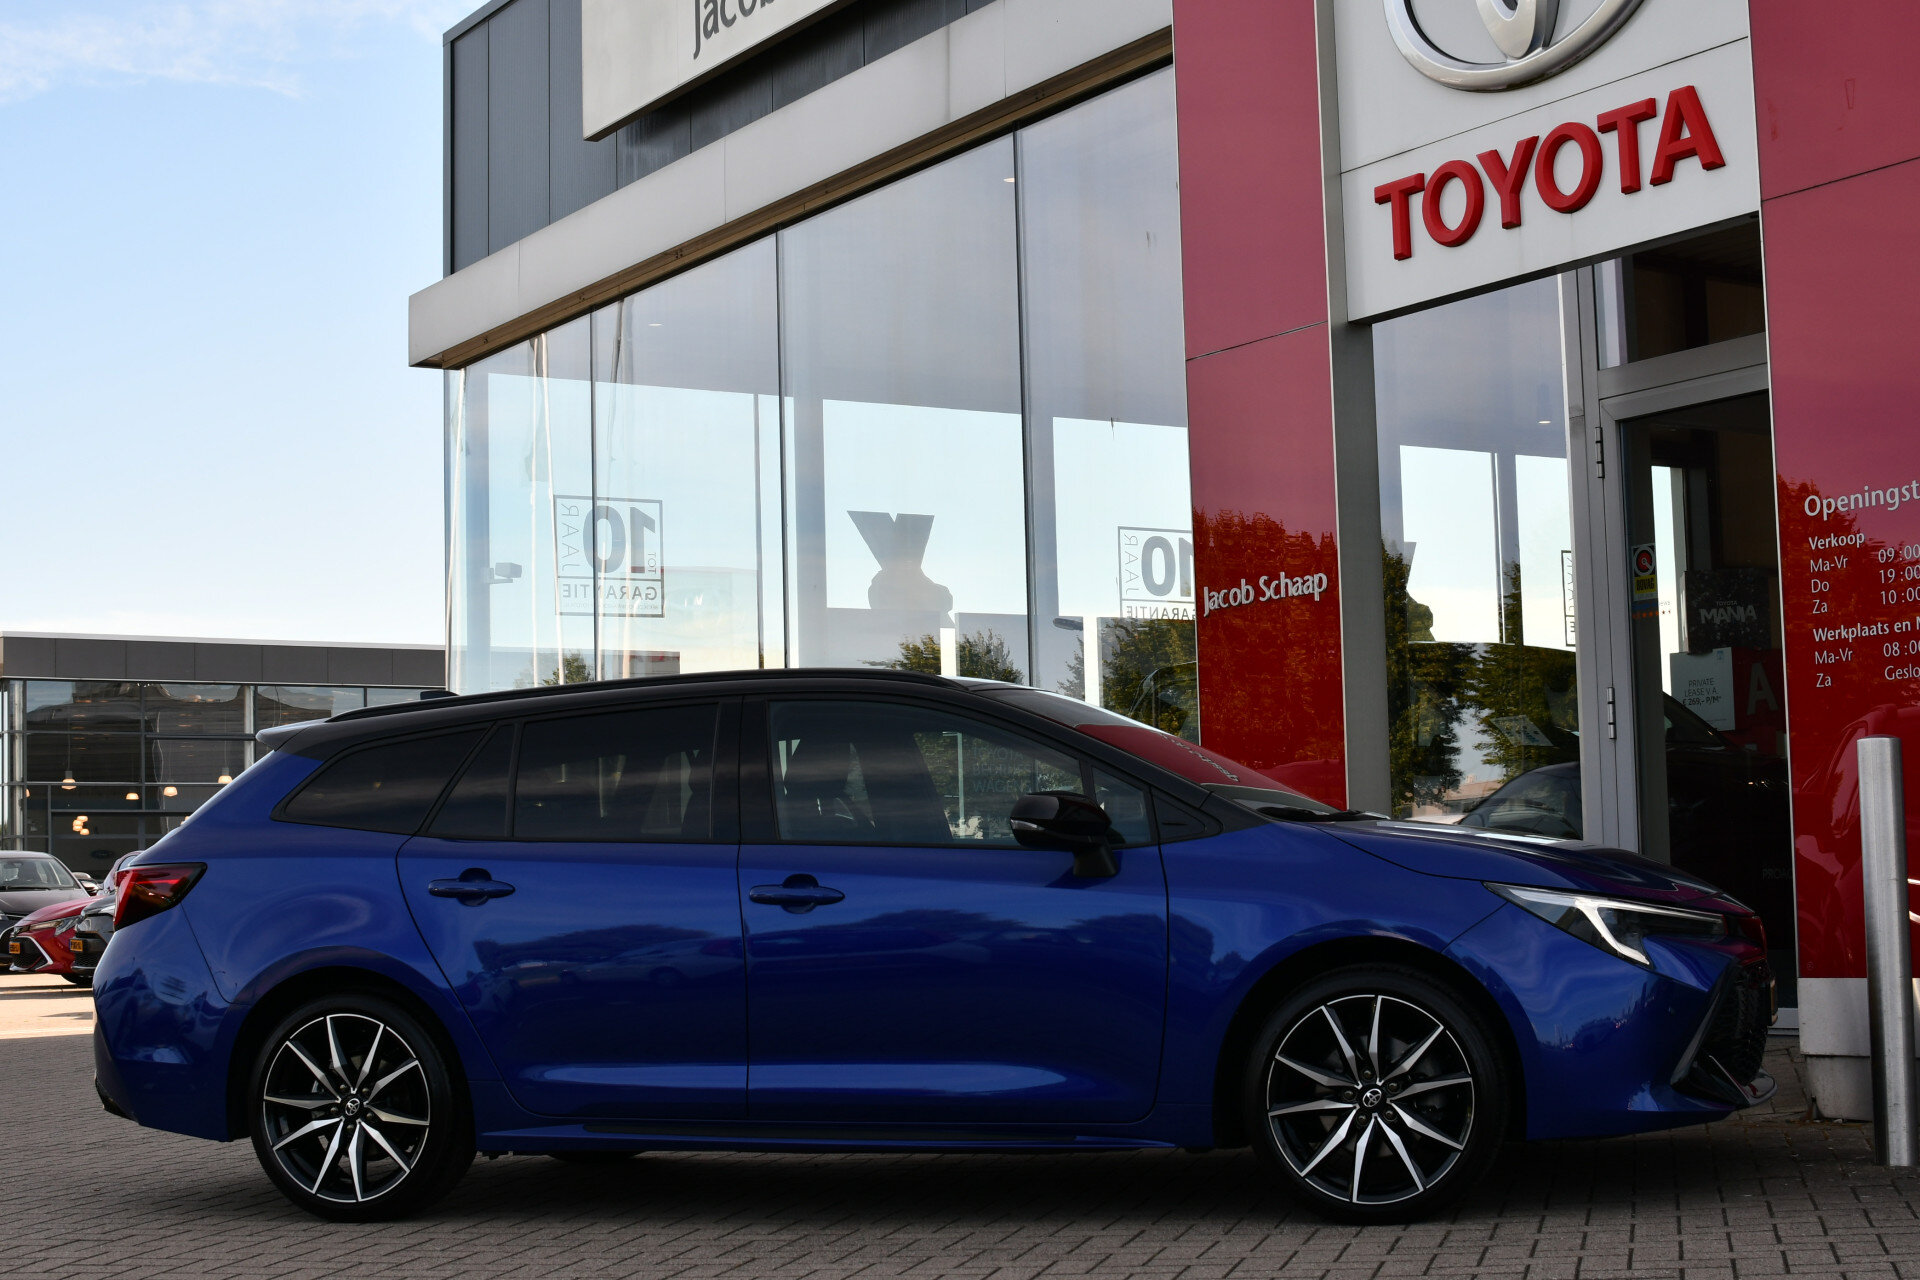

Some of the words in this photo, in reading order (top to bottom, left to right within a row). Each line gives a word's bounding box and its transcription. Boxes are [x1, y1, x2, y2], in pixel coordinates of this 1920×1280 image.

[693, 0, 775, 60] Jac
[1374, 85, 1726, 260] TOYOTA
[1804, 480, 1920, 521] Openingst
[1808, 533, 1865, 550] Verkoop
[1810, 555, 1848, 573] Ma-Vr
[1203, 579, 1255, 617] Jacob
[1259, 571, 1328, 602] Schaap
[1811, 579, 1830, 593] Do
[1700, 604, 1757, 624] MANIA
[1812, 600, 1828, 614] Za
[1812, 622, 1890, 643] Werkplaats
[1894, 620, 1912, 633] en
[1815, 648, 1853, 664] Ma-Vr
[1688, 678, 1715, 687] PRIVATE
[1816, 673, 1832, 688] Za
[1884, 664, 1920, 680] Geslo
[1684, 688, 1705, 697] LEASE
